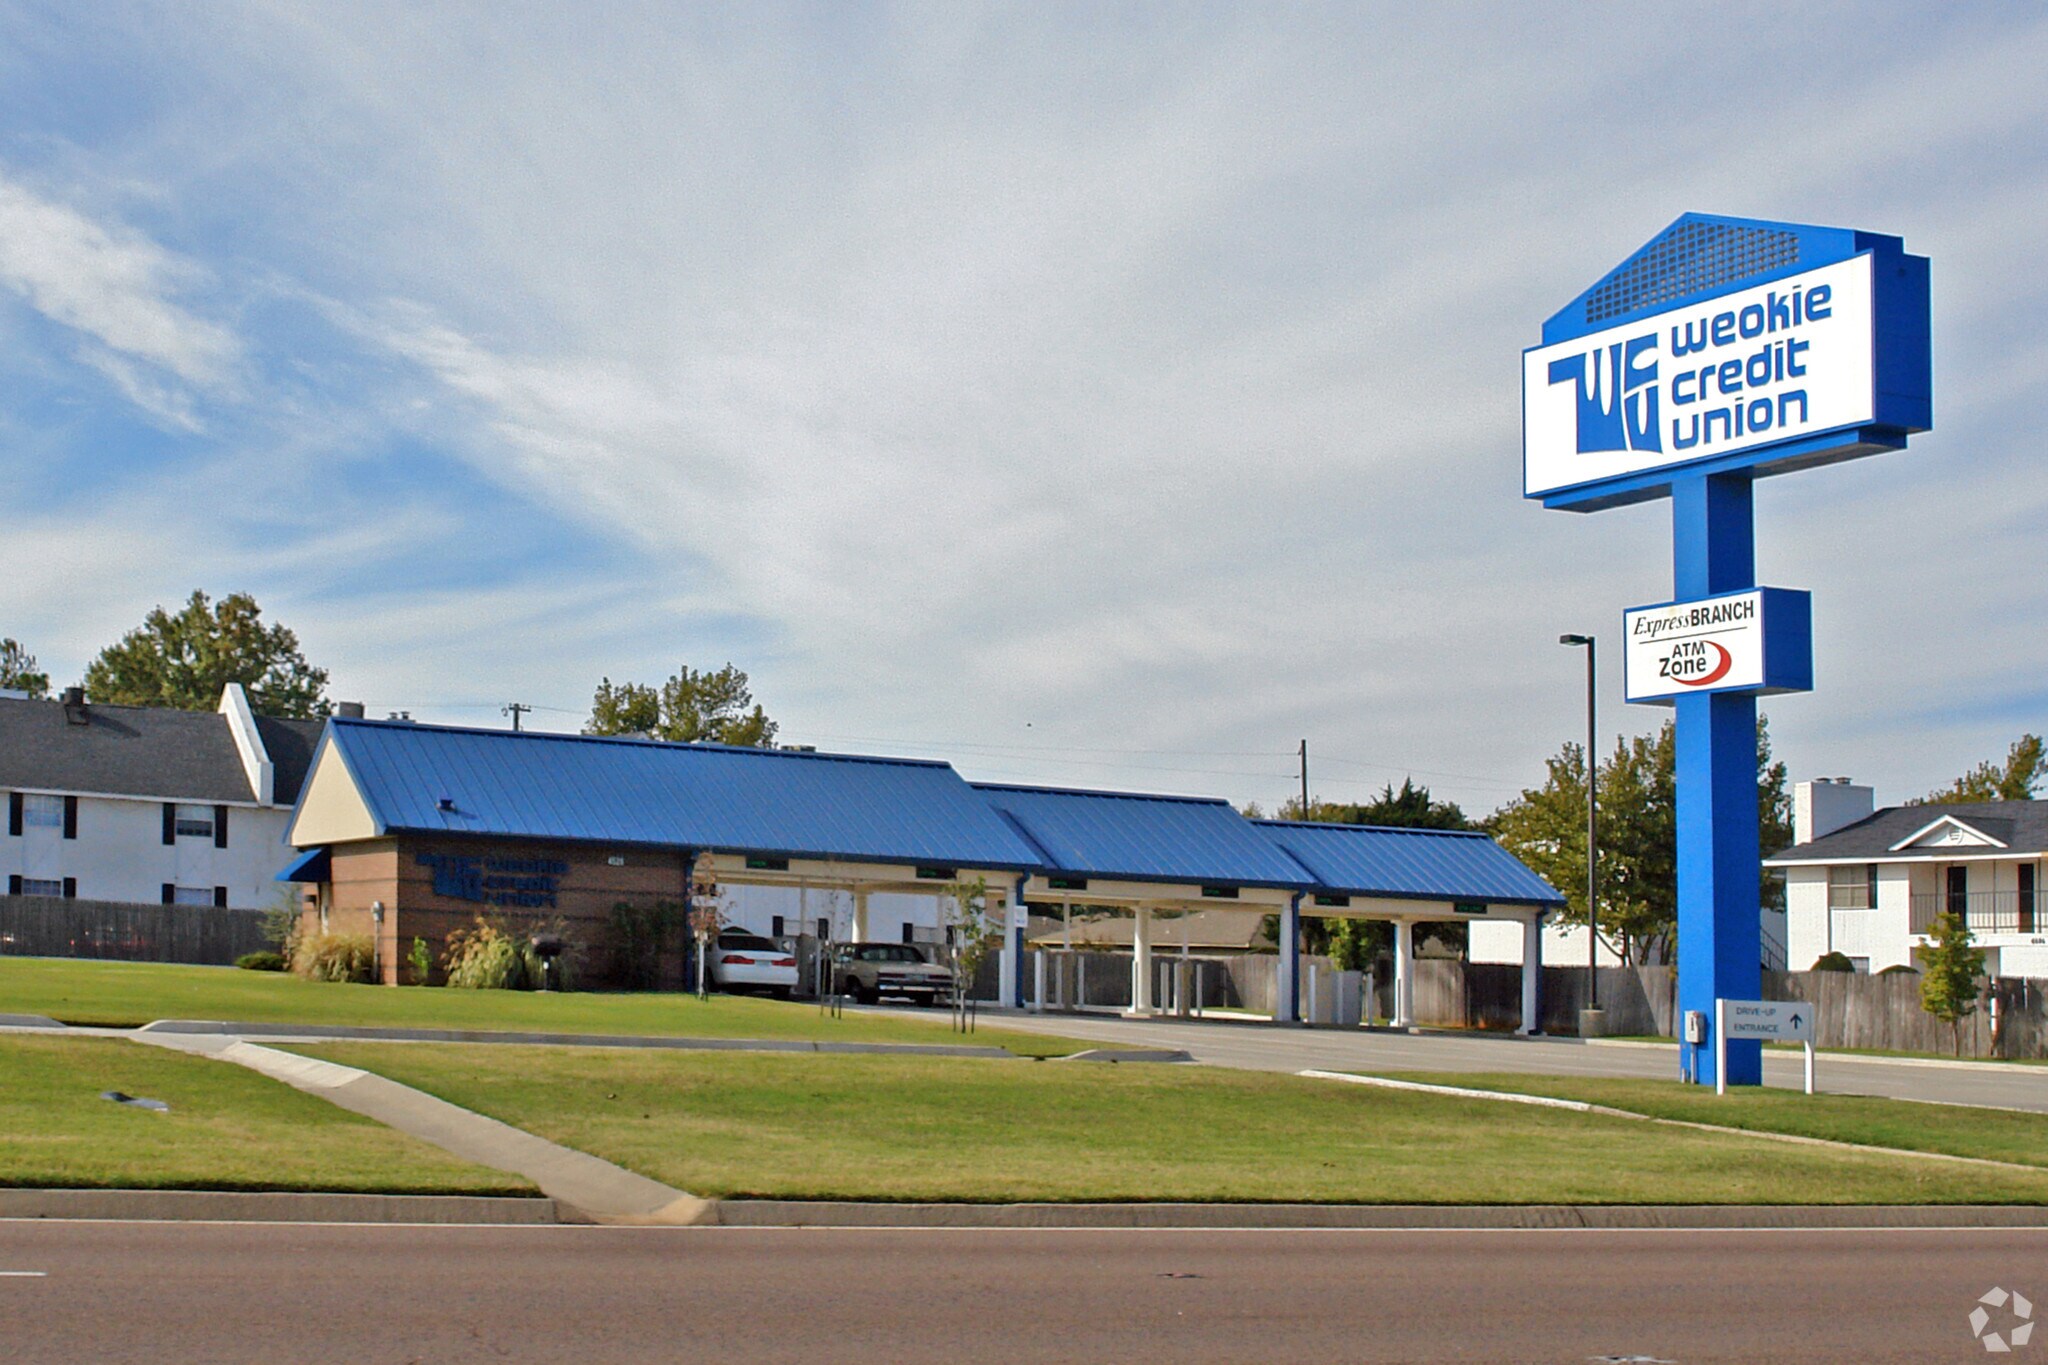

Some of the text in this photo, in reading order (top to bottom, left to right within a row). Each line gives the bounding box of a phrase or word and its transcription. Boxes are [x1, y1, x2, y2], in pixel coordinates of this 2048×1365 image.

[1671, 284, 1832, 358] weokie
[1671, 336, 1810, 407] credit
[1672, 389, 1809, 450] union
[1659, 656, 1707, 678] Zone
[1672, 641, 1706, 659] ATM
[1734, 1024, 1779, 1033] ENTRANCE
